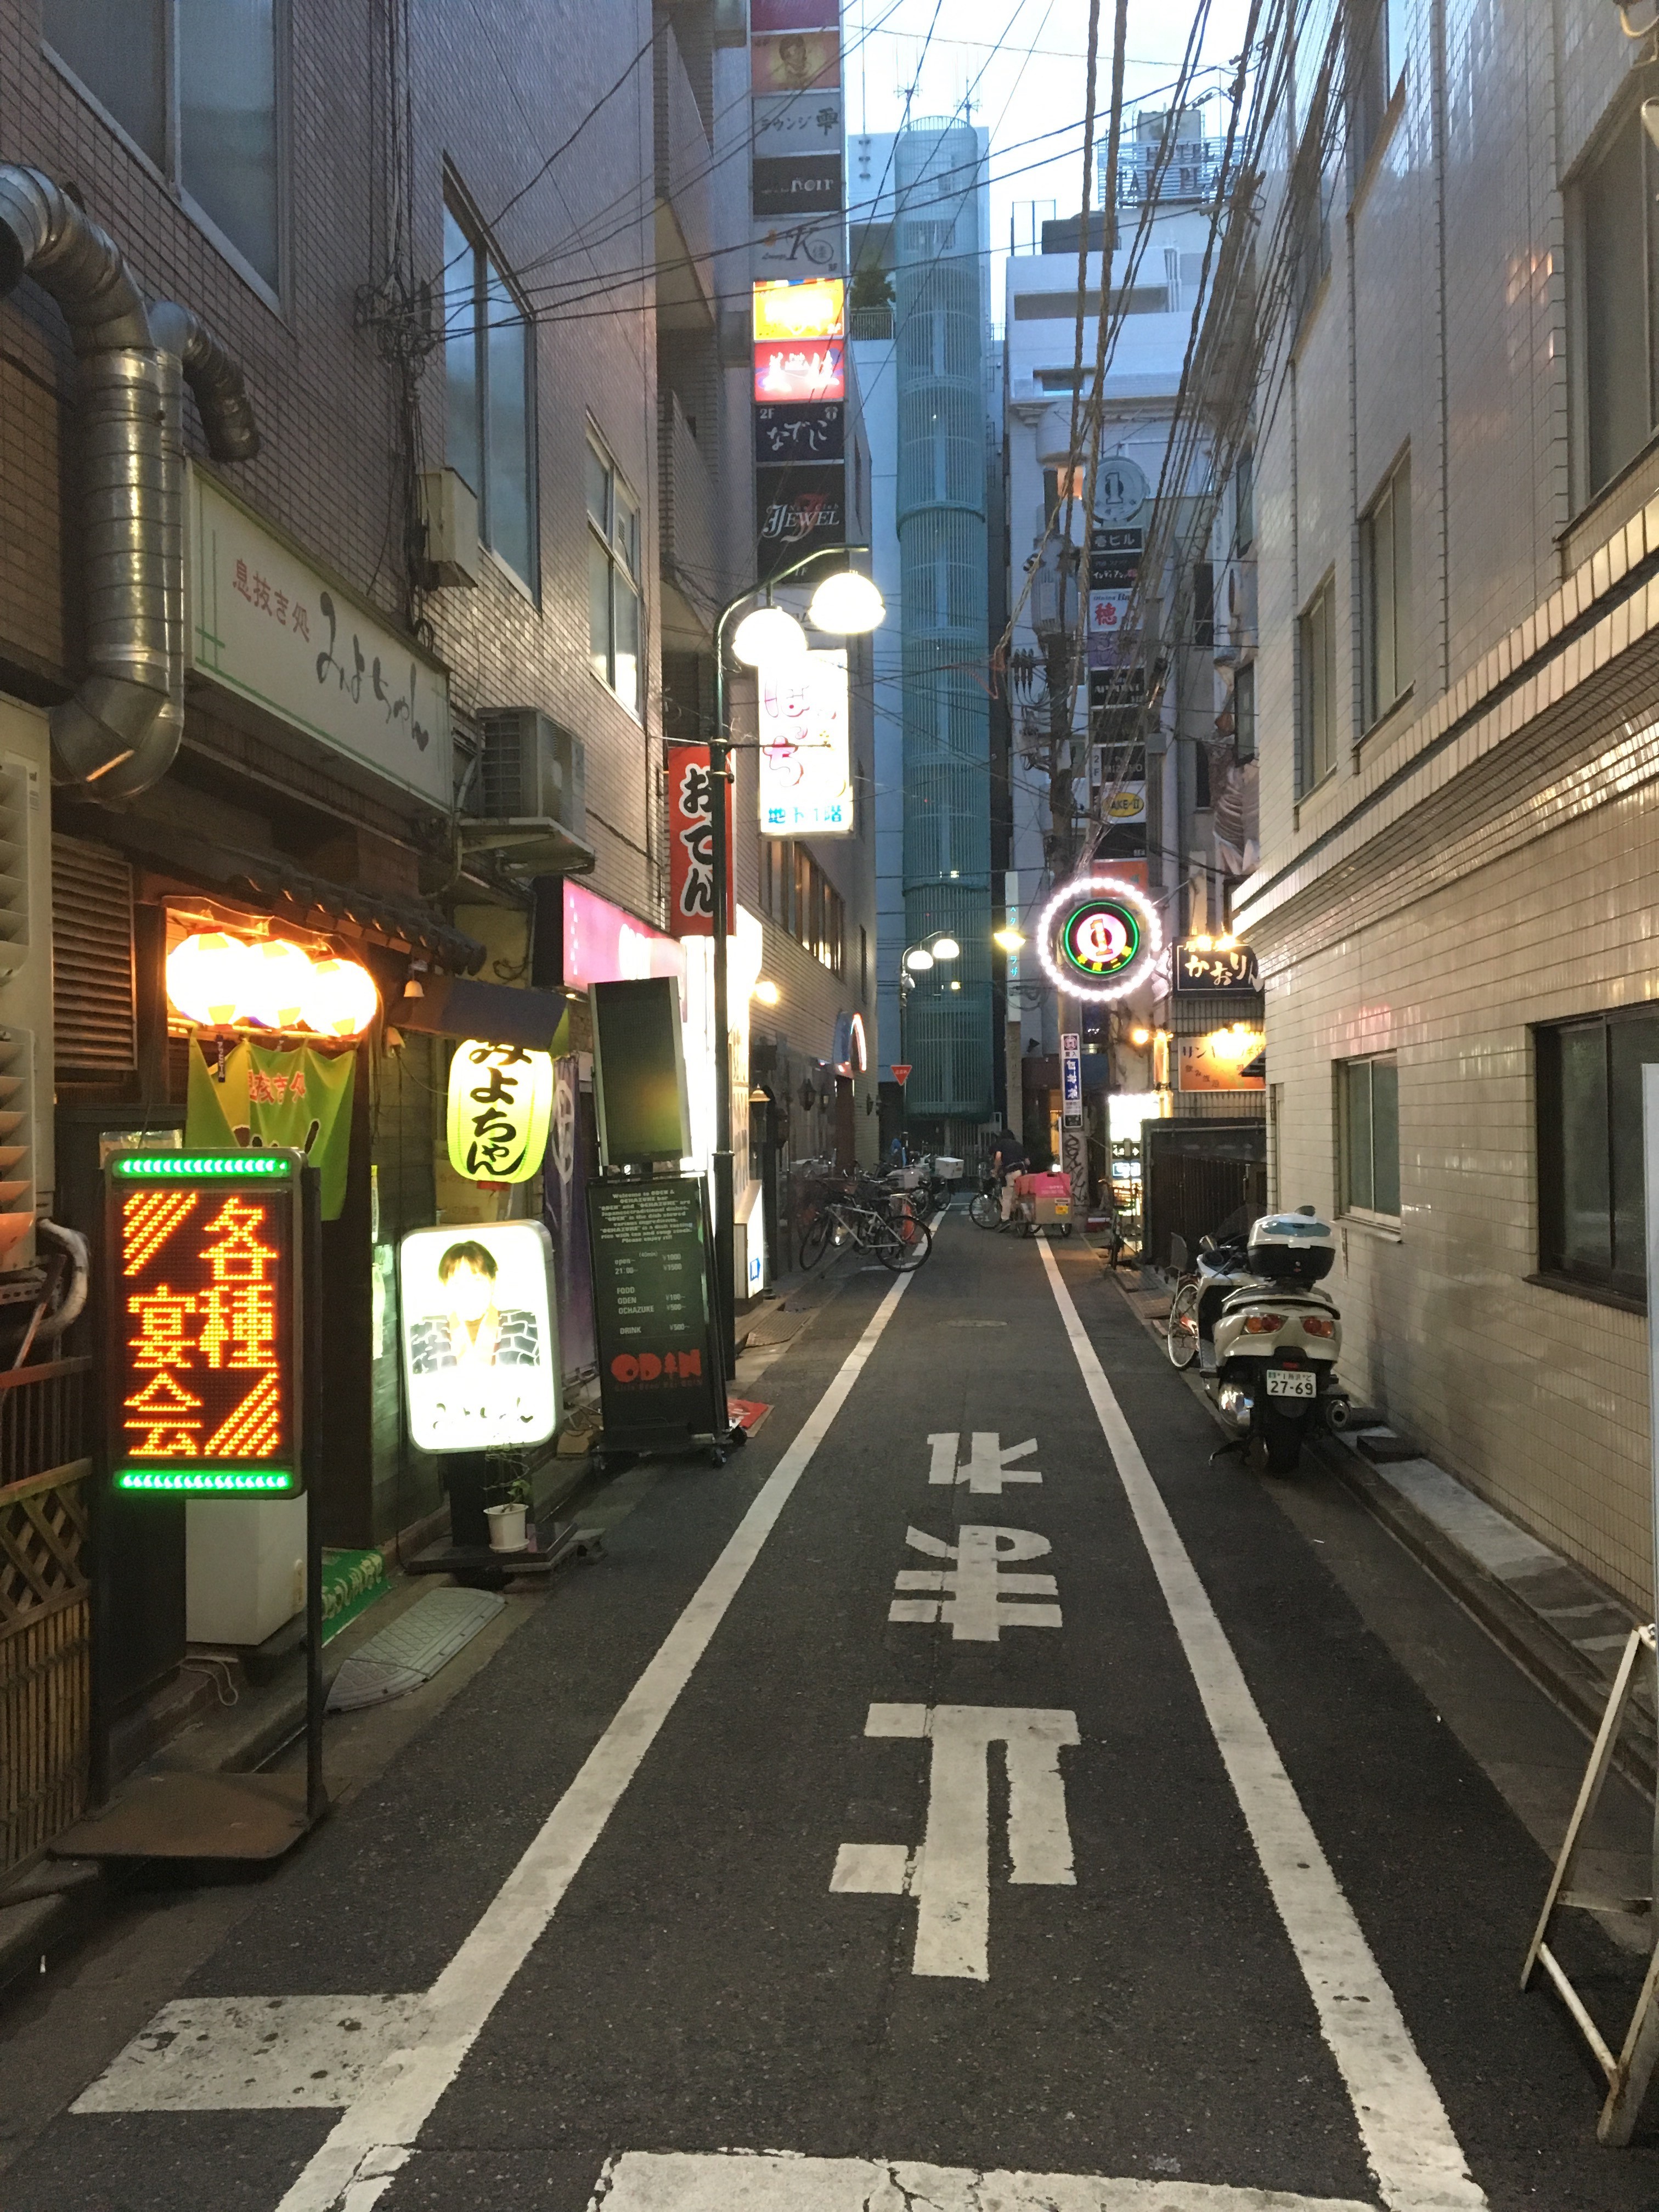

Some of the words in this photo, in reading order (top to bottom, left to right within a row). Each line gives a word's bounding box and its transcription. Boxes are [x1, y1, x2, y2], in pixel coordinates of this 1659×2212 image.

[760, 408, 775, 420] 2F
[763, 504, 839, 539] JEWEL
[232, 558, 310, 642] 息抜き処
[1066, 1059, 1079, 1099] セキネ
[199, 1196, 278, 1368] 各種
[618, 1305, 654, 1314] OCHAZUKE
[123, 1284, 202, 1456] 宴会
[1270, 1380, 1313, 1395] 27-69
